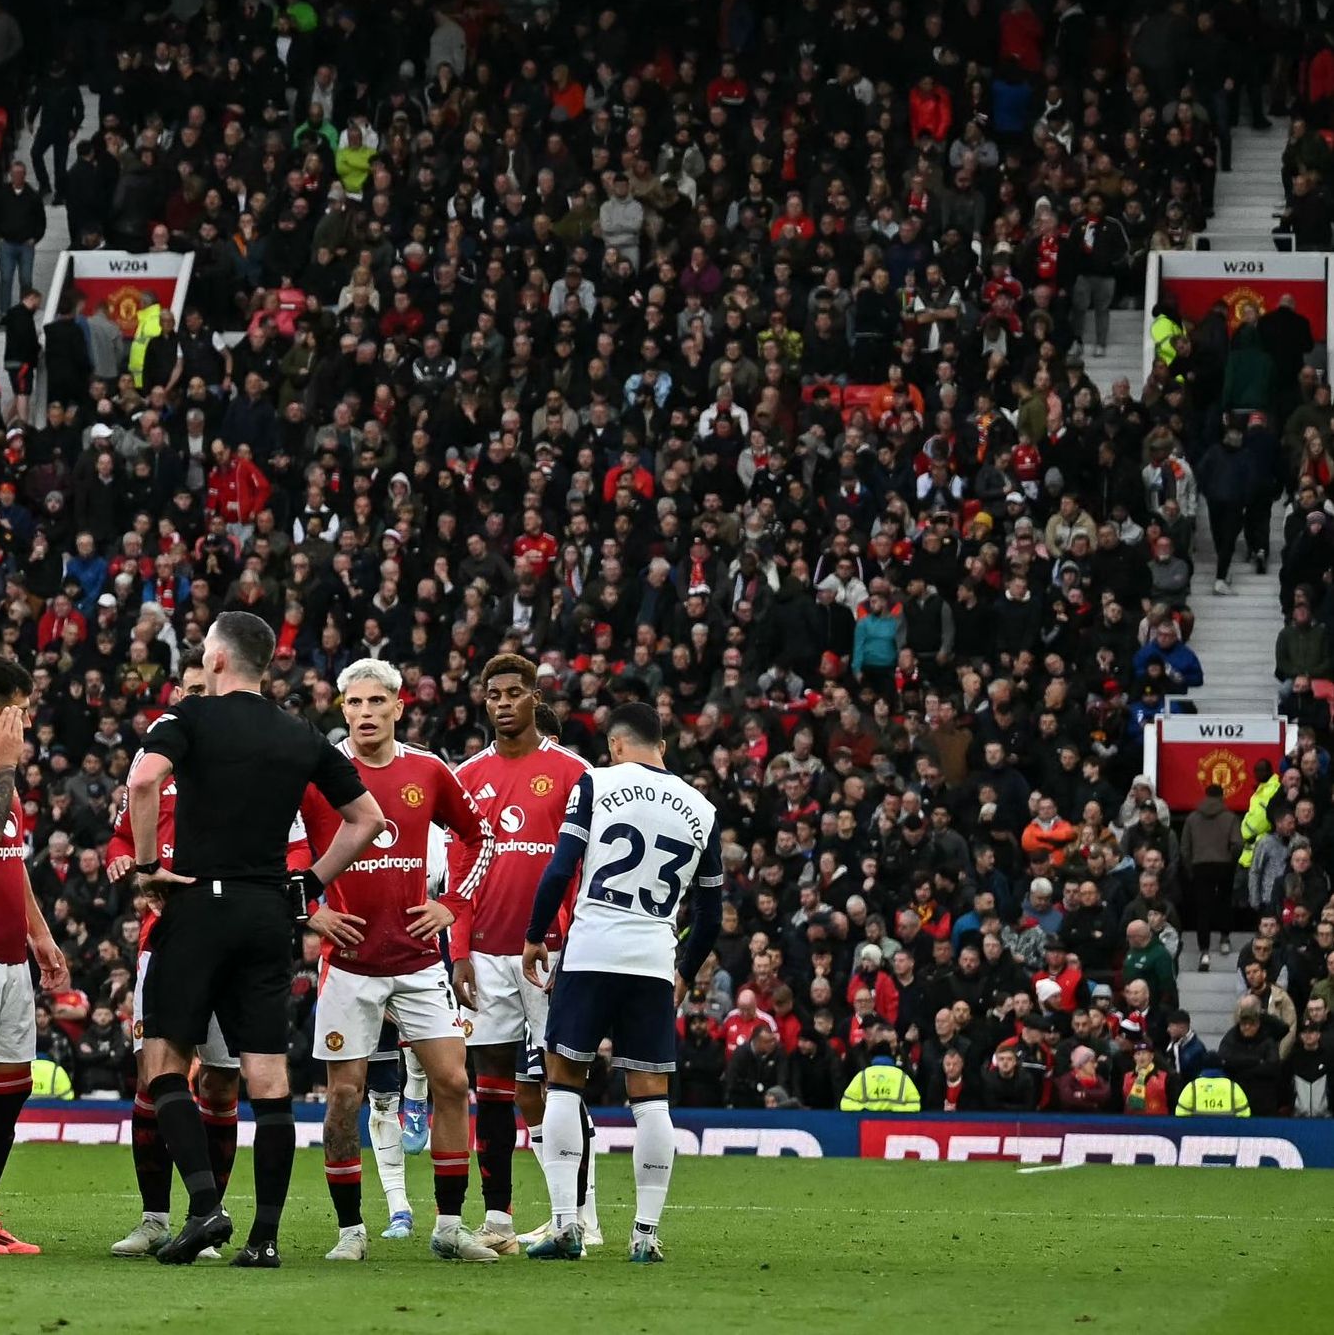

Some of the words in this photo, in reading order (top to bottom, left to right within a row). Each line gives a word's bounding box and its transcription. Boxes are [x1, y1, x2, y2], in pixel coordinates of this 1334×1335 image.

[109, 260, 148, 272] W204
[1223, 261, 1264, 273] W203
[1199, 724, 1244, 737] W102
[600, 785, 656, 814] PEDRO
[661, 791, 704, 842] PORRO
[587, 822, 695, 919] 23
